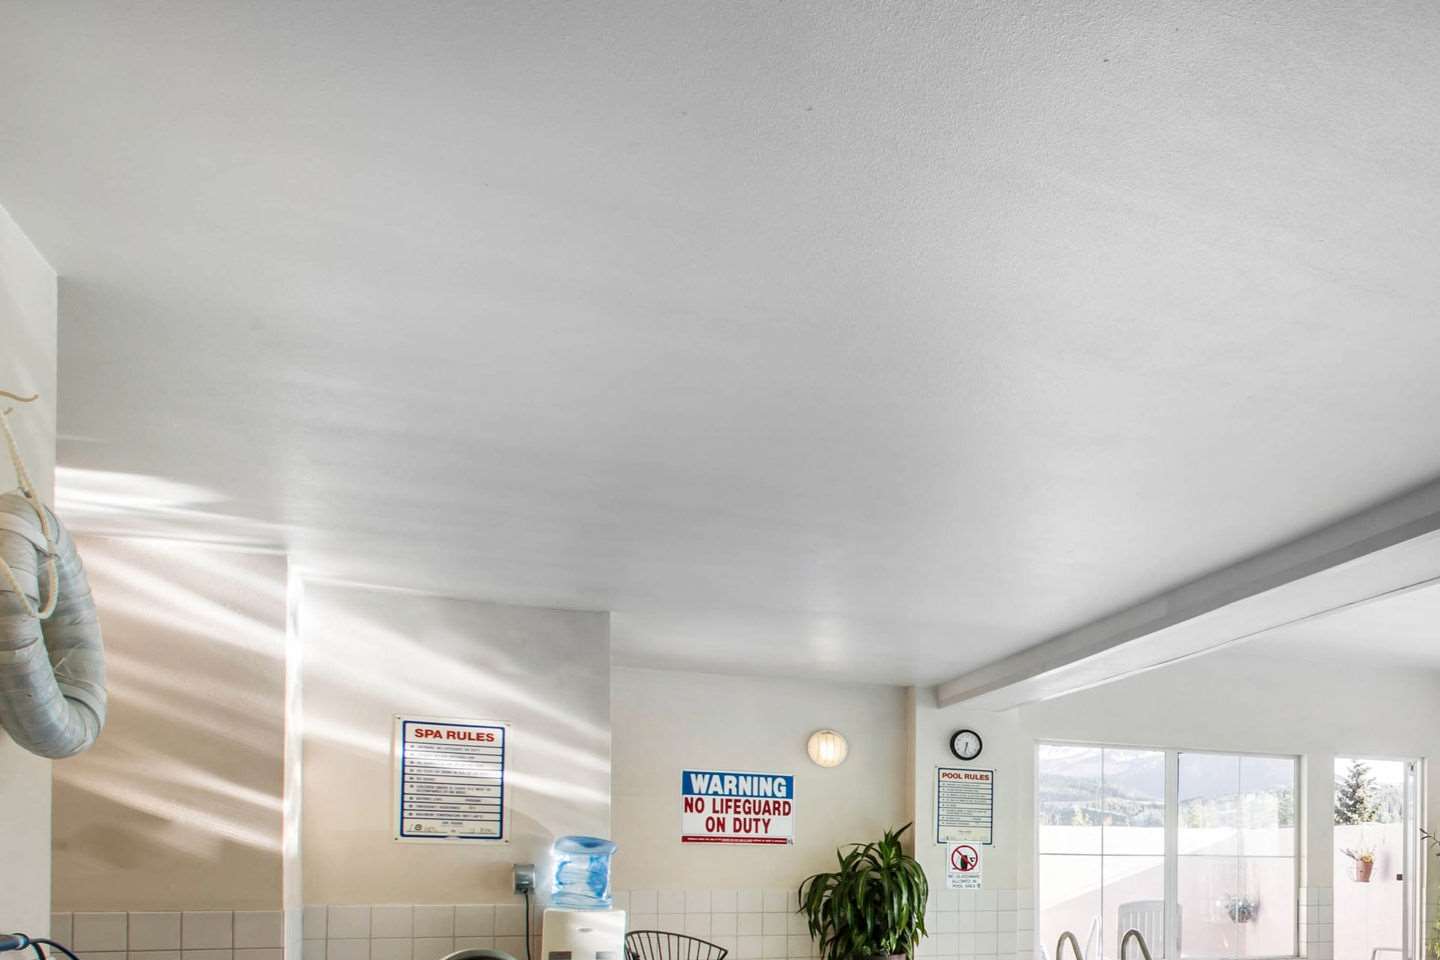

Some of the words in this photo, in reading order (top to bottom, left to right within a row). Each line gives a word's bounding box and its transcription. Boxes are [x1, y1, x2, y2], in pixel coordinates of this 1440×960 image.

[414, 727, 443, 740] SPA
[446, 730, 495, 742] RULES
[690, 773, 787, 797] WARNING
[942, 772, 963, 780] POOL
[964, 773, 989, 781] RULES
[684, 797, 705, 813] NO
[712, 798, 791, 816] LIFEGUARD
[705, 816, 726, 833] ON
[733, 817, 771, 834] DUTY
